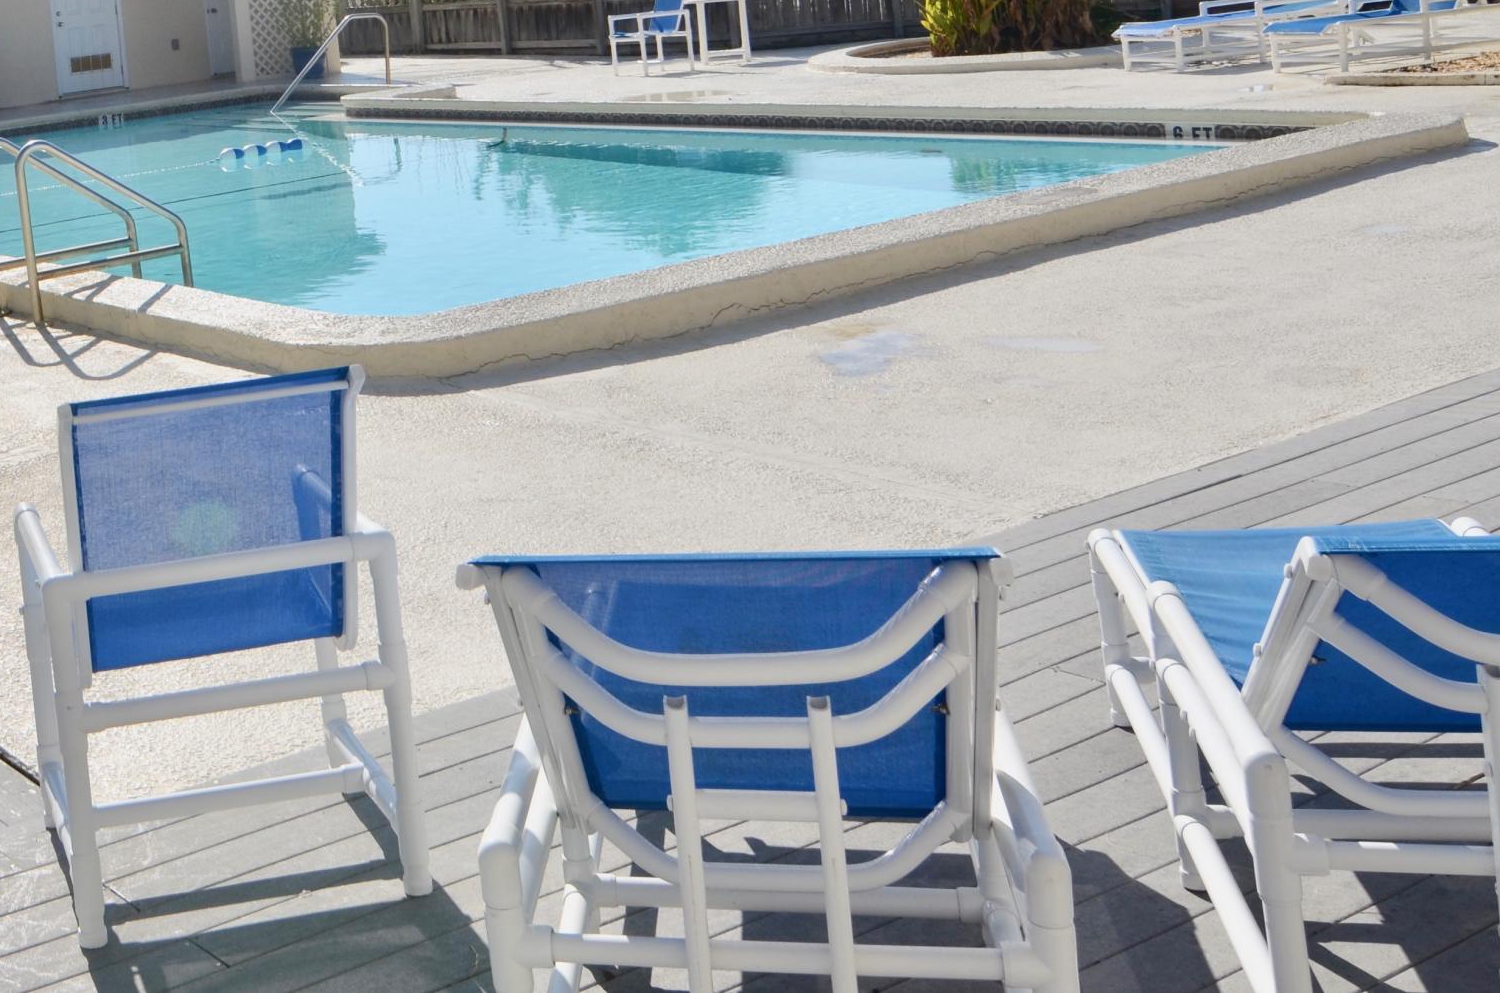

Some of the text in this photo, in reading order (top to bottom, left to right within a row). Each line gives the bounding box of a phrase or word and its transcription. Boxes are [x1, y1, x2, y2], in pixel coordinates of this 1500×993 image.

[112, 113, 122, 125] FT
[1173, 126, 1212, 139] 6 FT
